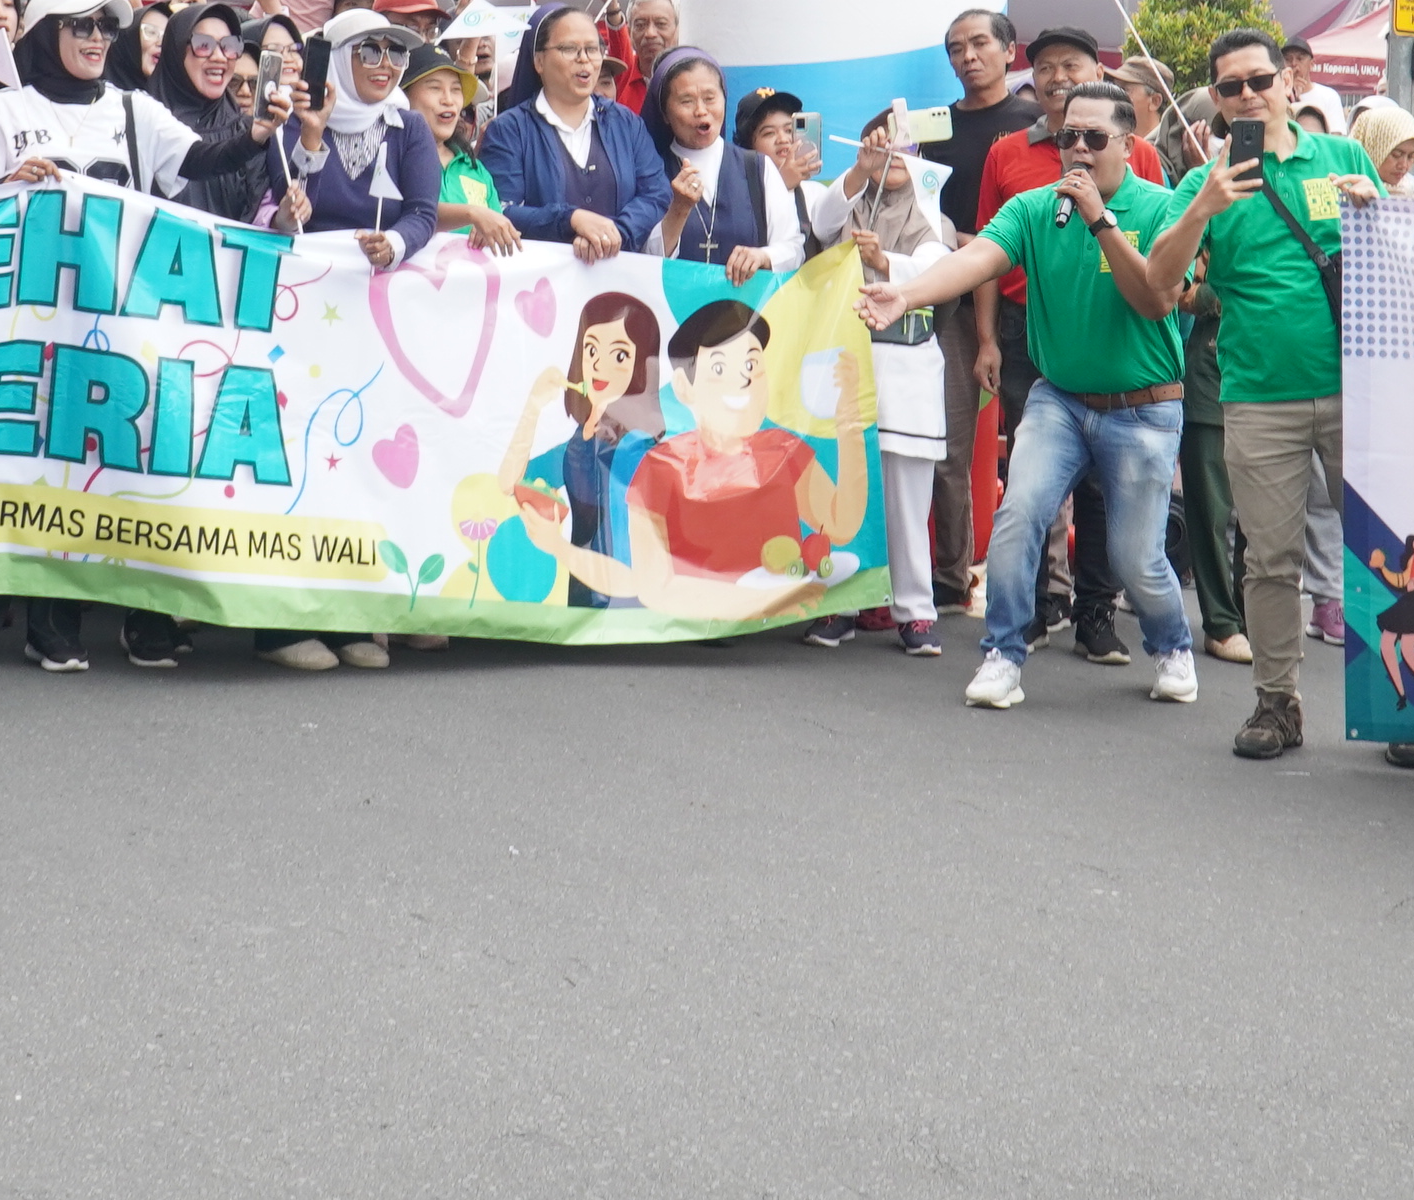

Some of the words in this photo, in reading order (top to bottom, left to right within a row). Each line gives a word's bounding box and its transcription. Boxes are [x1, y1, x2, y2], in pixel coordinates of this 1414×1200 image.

[94, 516, 238, 557] BERSAMA
[247, 529, 302, 563] MAS
[312, 534, 378, 568] WALI
